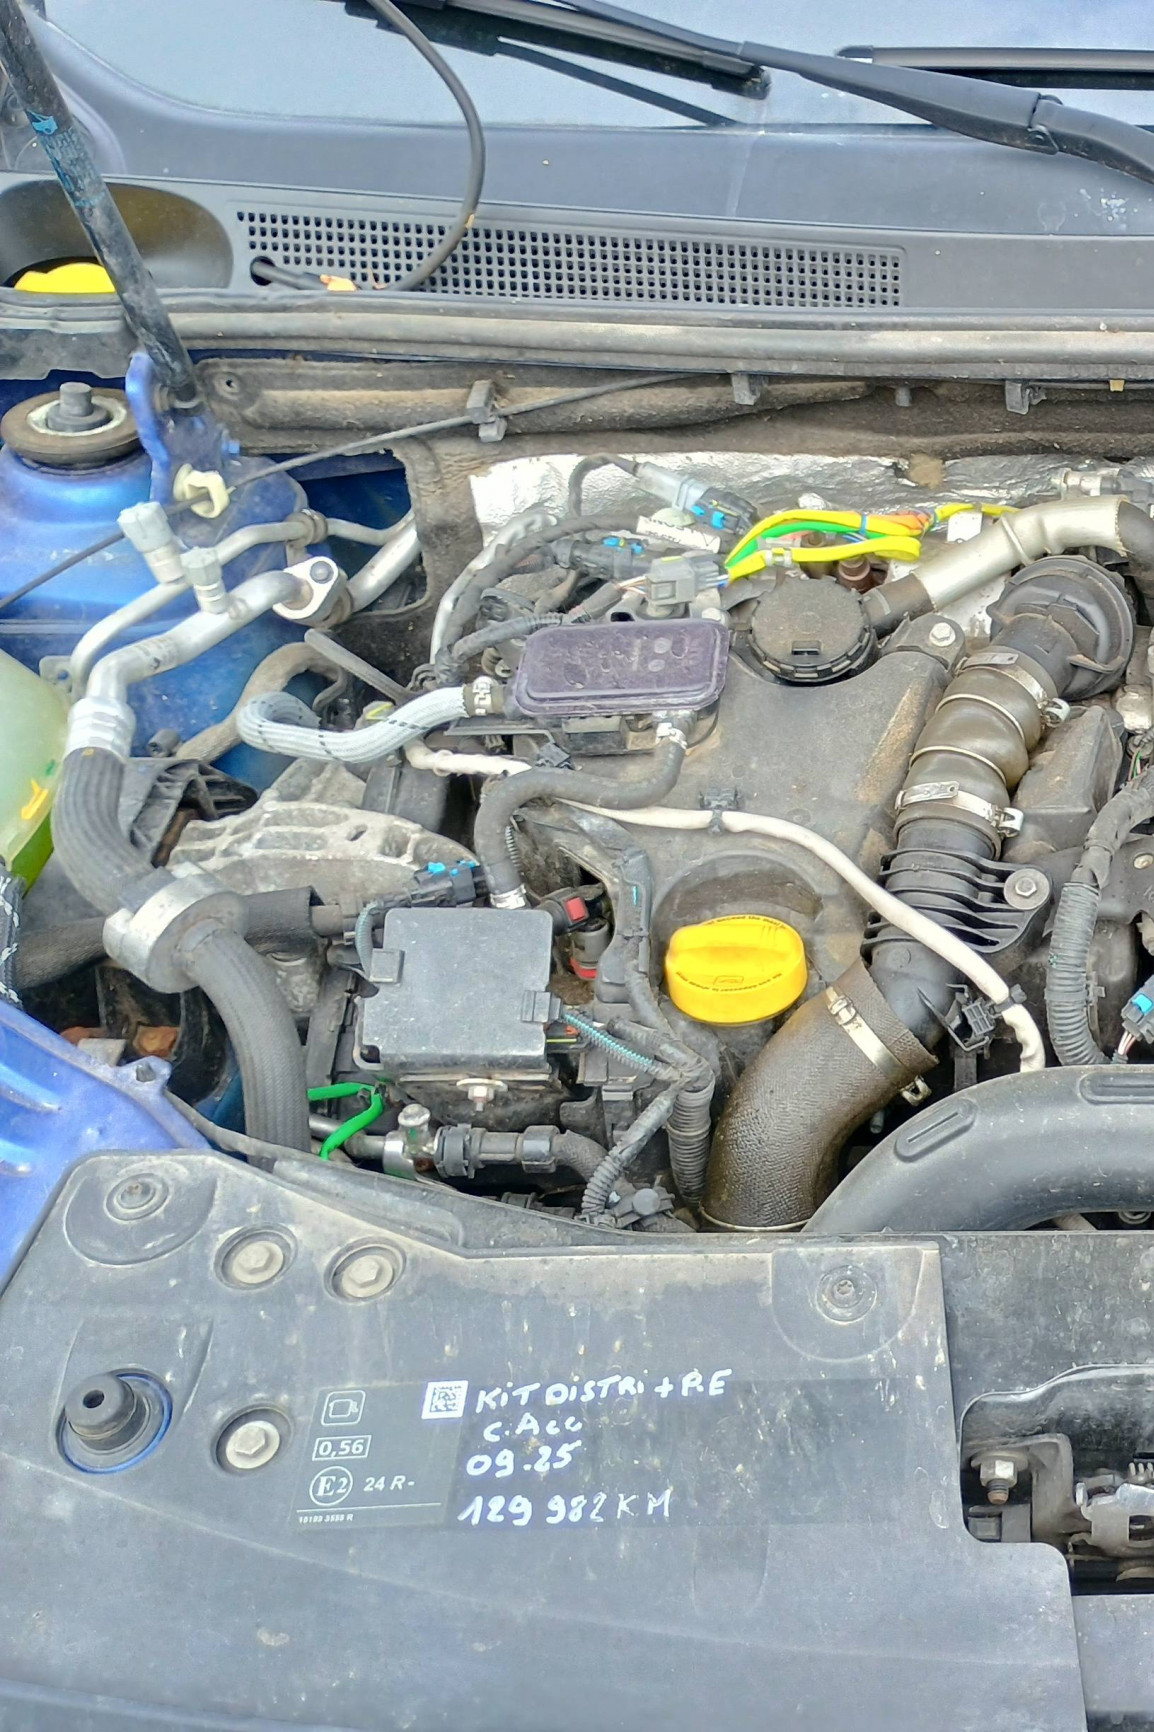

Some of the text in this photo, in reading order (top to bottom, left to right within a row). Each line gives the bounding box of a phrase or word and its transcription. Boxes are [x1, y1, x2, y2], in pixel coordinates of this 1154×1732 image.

[654, 1376, 674, 1398] +
[318, 1439, 364, 1458] 0,56
[466, 1440, 582, 1478] 09.25
[316, 1475, 348, 1497] E2
[363, 1476, 386, 1492] 24
